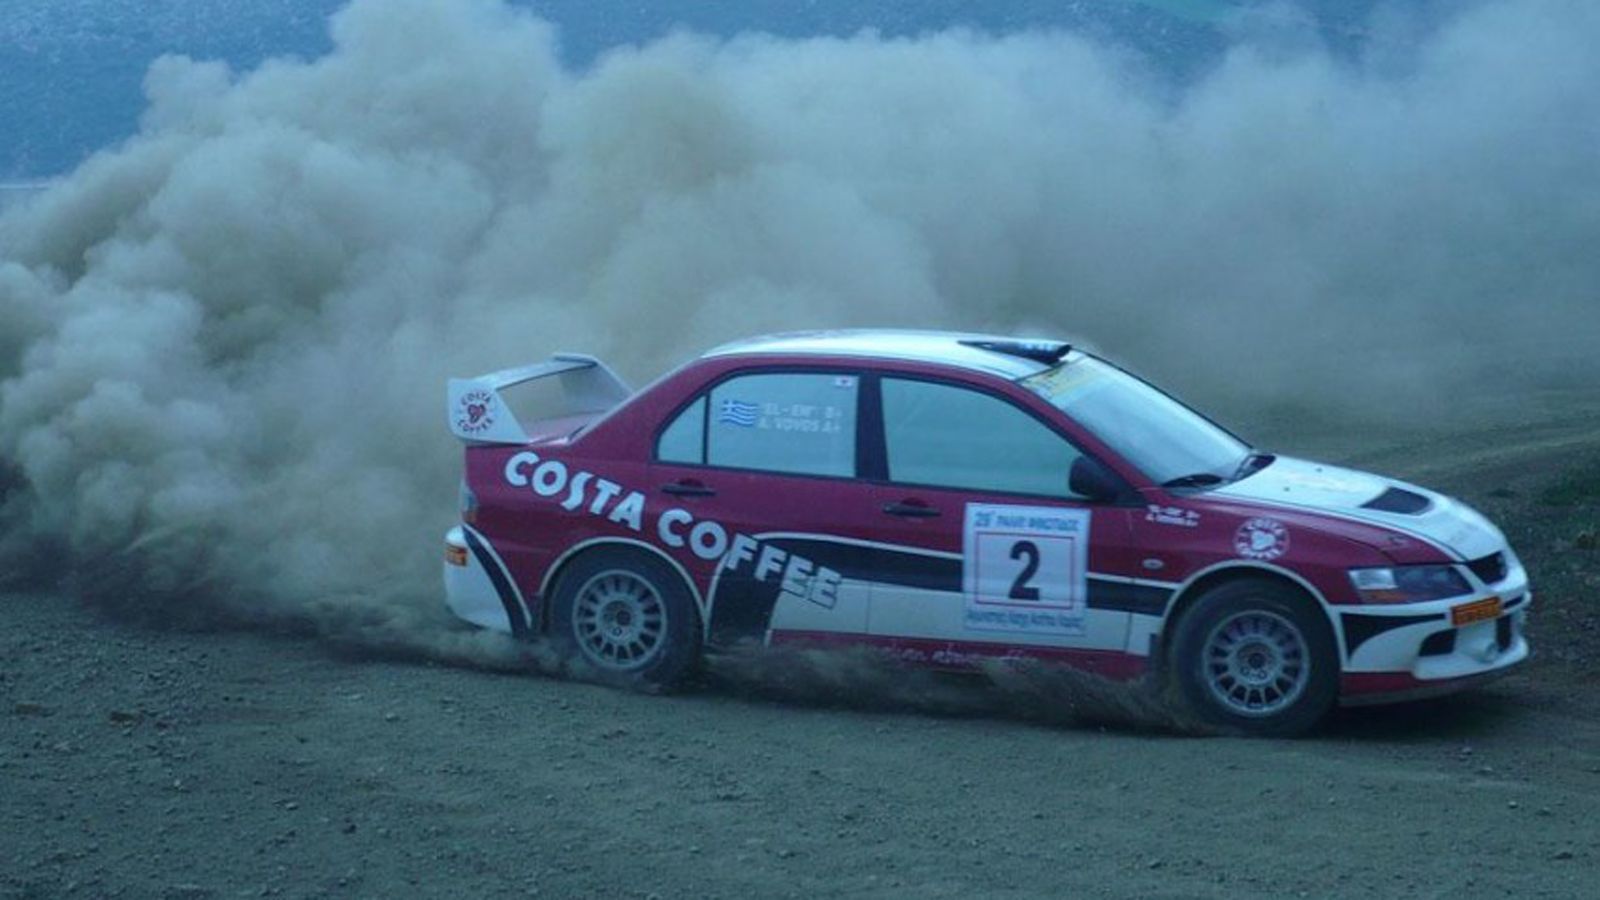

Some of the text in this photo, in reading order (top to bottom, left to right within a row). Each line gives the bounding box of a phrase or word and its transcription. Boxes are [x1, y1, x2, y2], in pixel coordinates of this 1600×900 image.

[504, 451, 841, 610] COSTA COFFEE
[1009, 540, 1040, 601] 2
